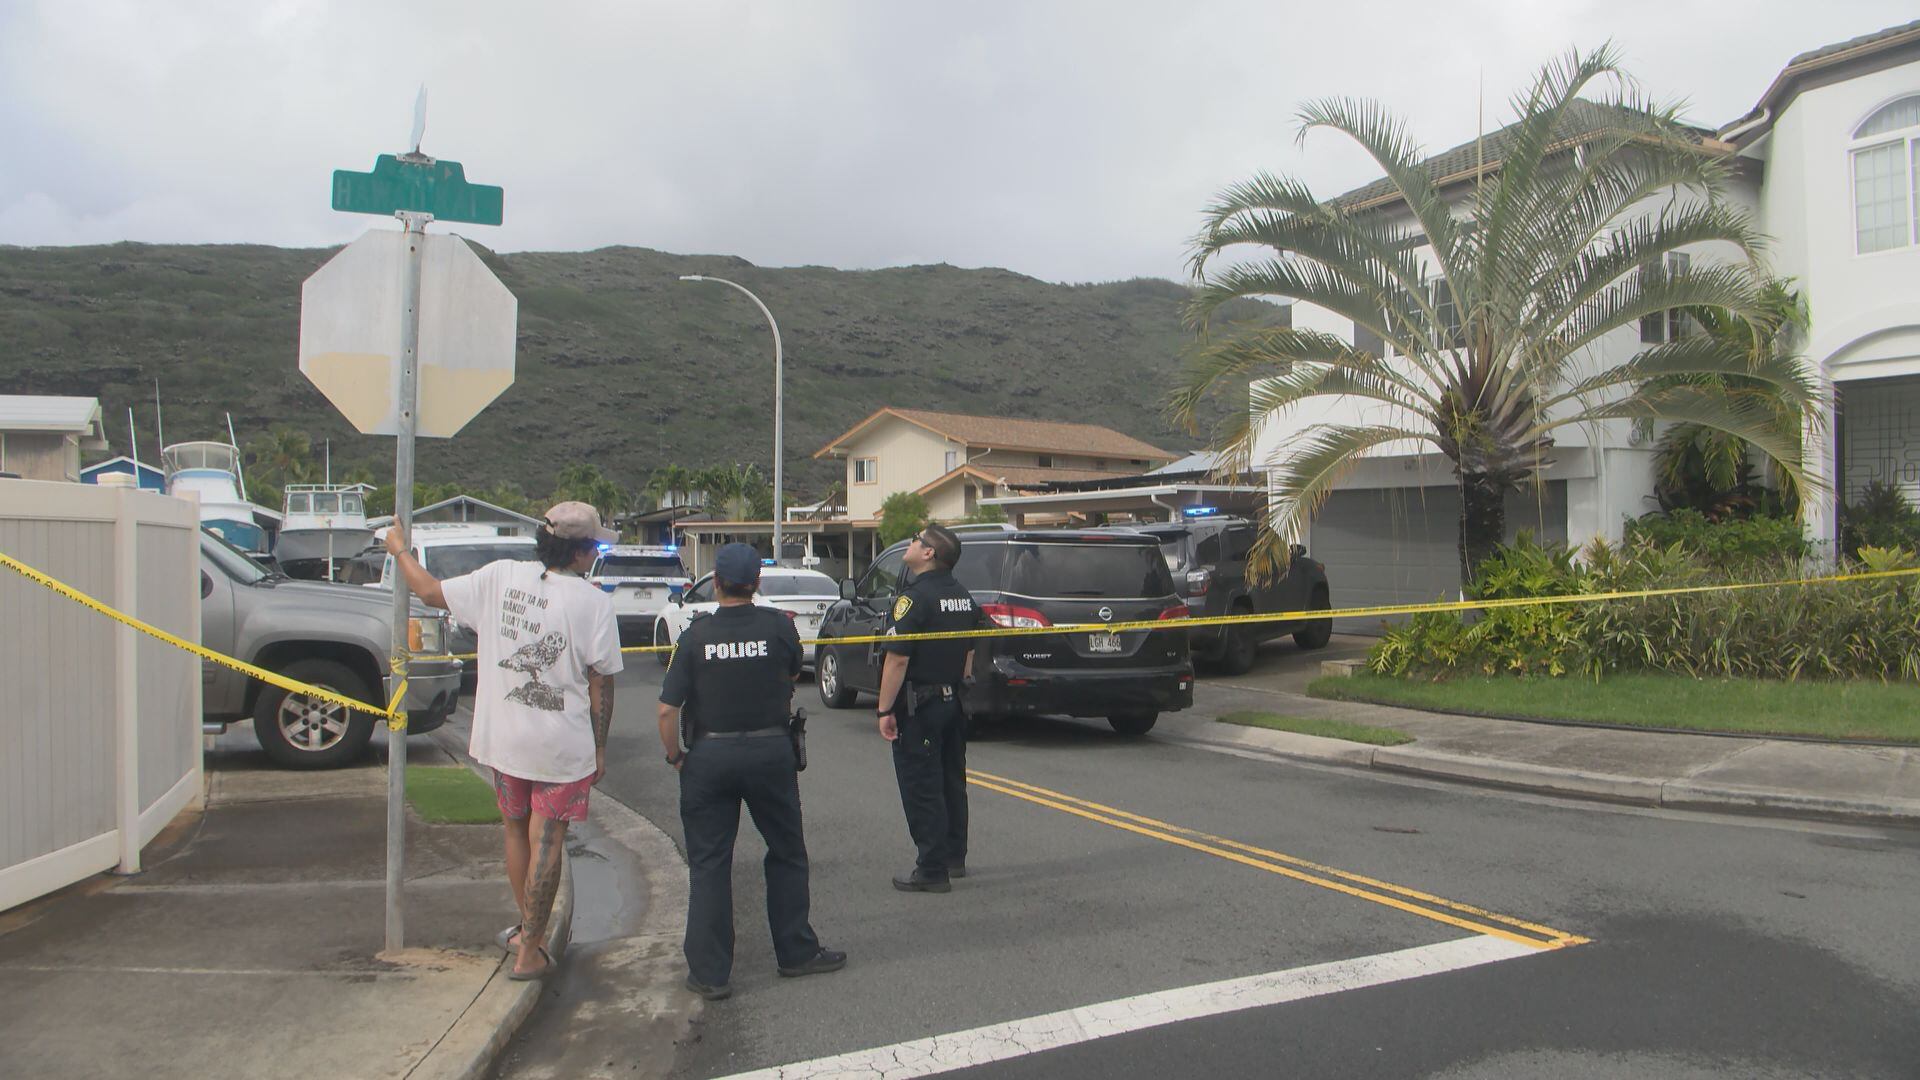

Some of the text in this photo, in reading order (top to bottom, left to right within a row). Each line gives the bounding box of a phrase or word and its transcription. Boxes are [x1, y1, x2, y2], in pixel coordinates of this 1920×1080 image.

[939, 598, 972, 612] POLICE
[704, 640, 768, 660] POLICE
[1022, 652, 1052, 660] QUEST
